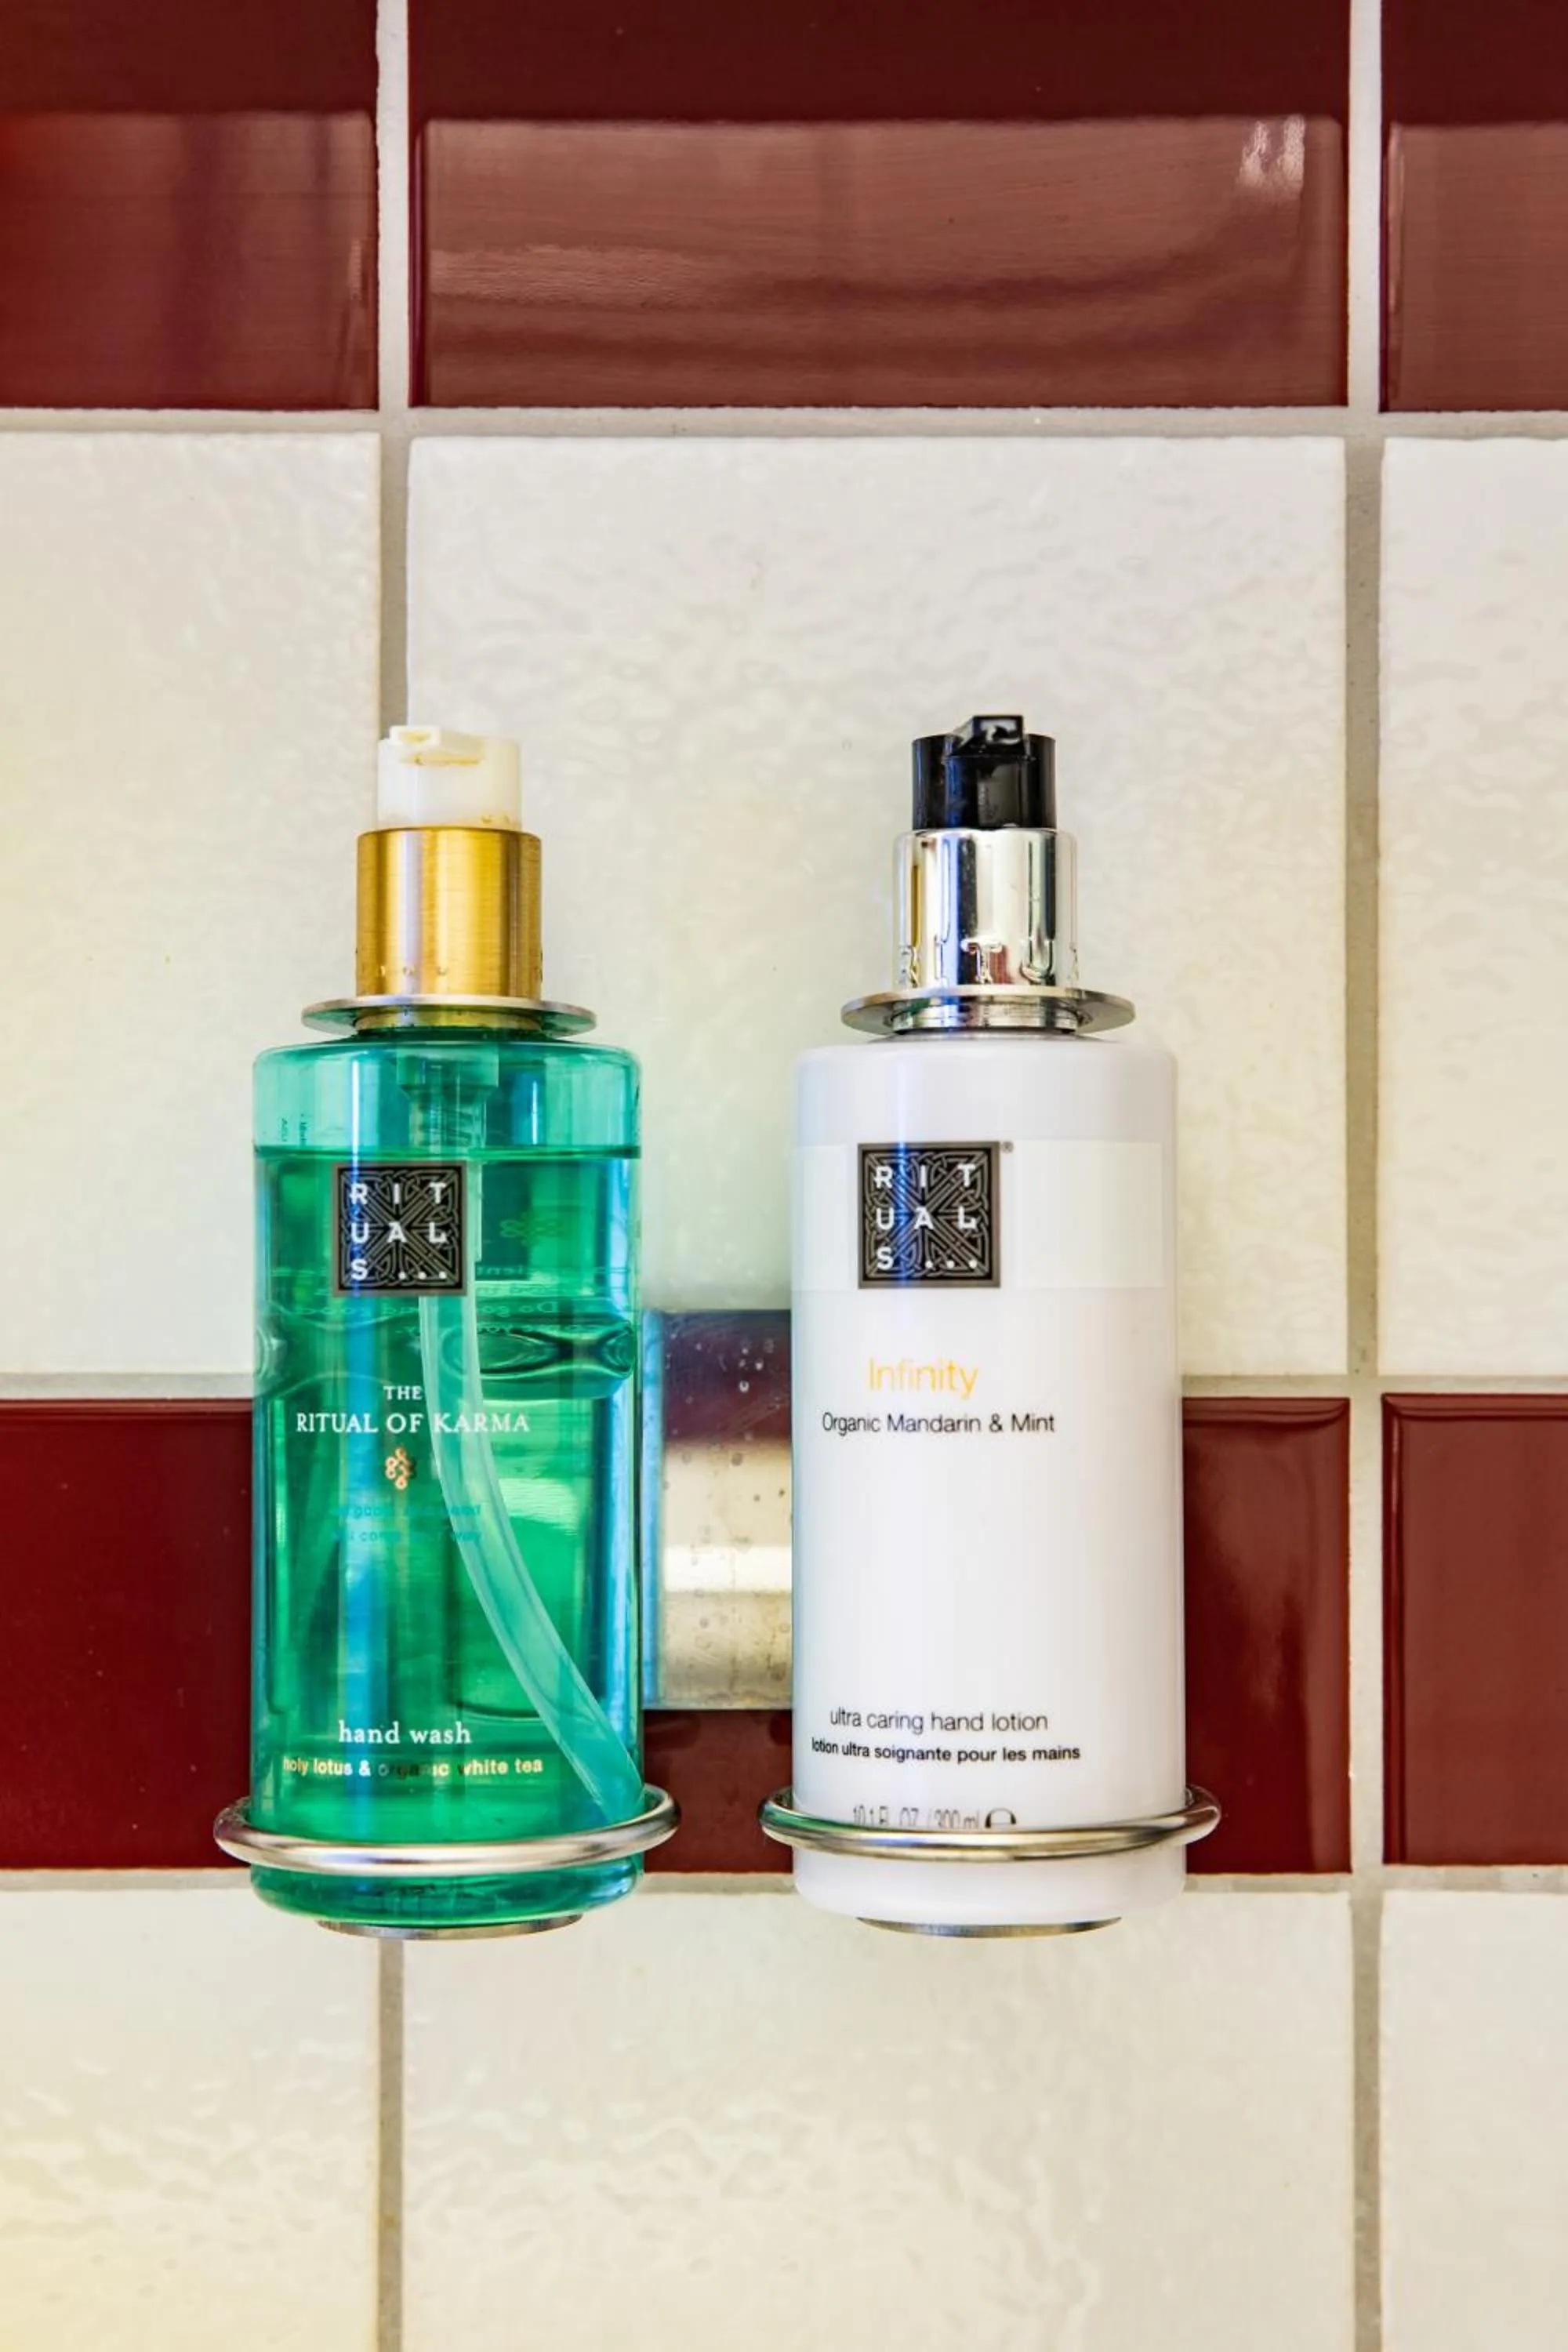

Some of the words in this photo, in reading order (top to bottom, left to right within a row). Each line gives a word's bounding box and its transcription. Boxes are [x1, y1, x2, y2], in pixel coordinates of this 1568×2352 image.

[868, 1358, 978, 1400] Infinity
[383, 1385, 423, 1399] THE
[296, 1414, 378, 1433] RITUAL
[386, 1414, 424, 1433] OF
[434, 1414, 530, 1433] KARMA
[822, 1411, 880, 1436] Organic
[887, 1414, 981, 1433] Mandarin
[989, 1414, 1003, 1433] &
[1011, 1414, 1055, 1432] Mint
[338, 1720, 401, 1744] hand
[409, 1722, 471, 1744] wash
[829, 1708, 862, 1727] ultra
[866, 1711, 924, 1734] caring
[931, 1712, 983, 1731] hand
[992, 1712, 1048, 1731] lotion
[811, 1737, 838, 1755] lotion
[842, 1740, 869, 1758] ultra
[874, 1745, 952, 1763] soignante
[957, 1748, 996, 1764] pour
[1003, 1746, 1026, 1761] les
[1032, 1745, 1080, 1761] mains
[283, 1756, 309, 1776] holy
[313, 1761, 353, 1776] lotus
[358, 1760, 371, 1777] &
[514, 1758, 543, 1773] tea
